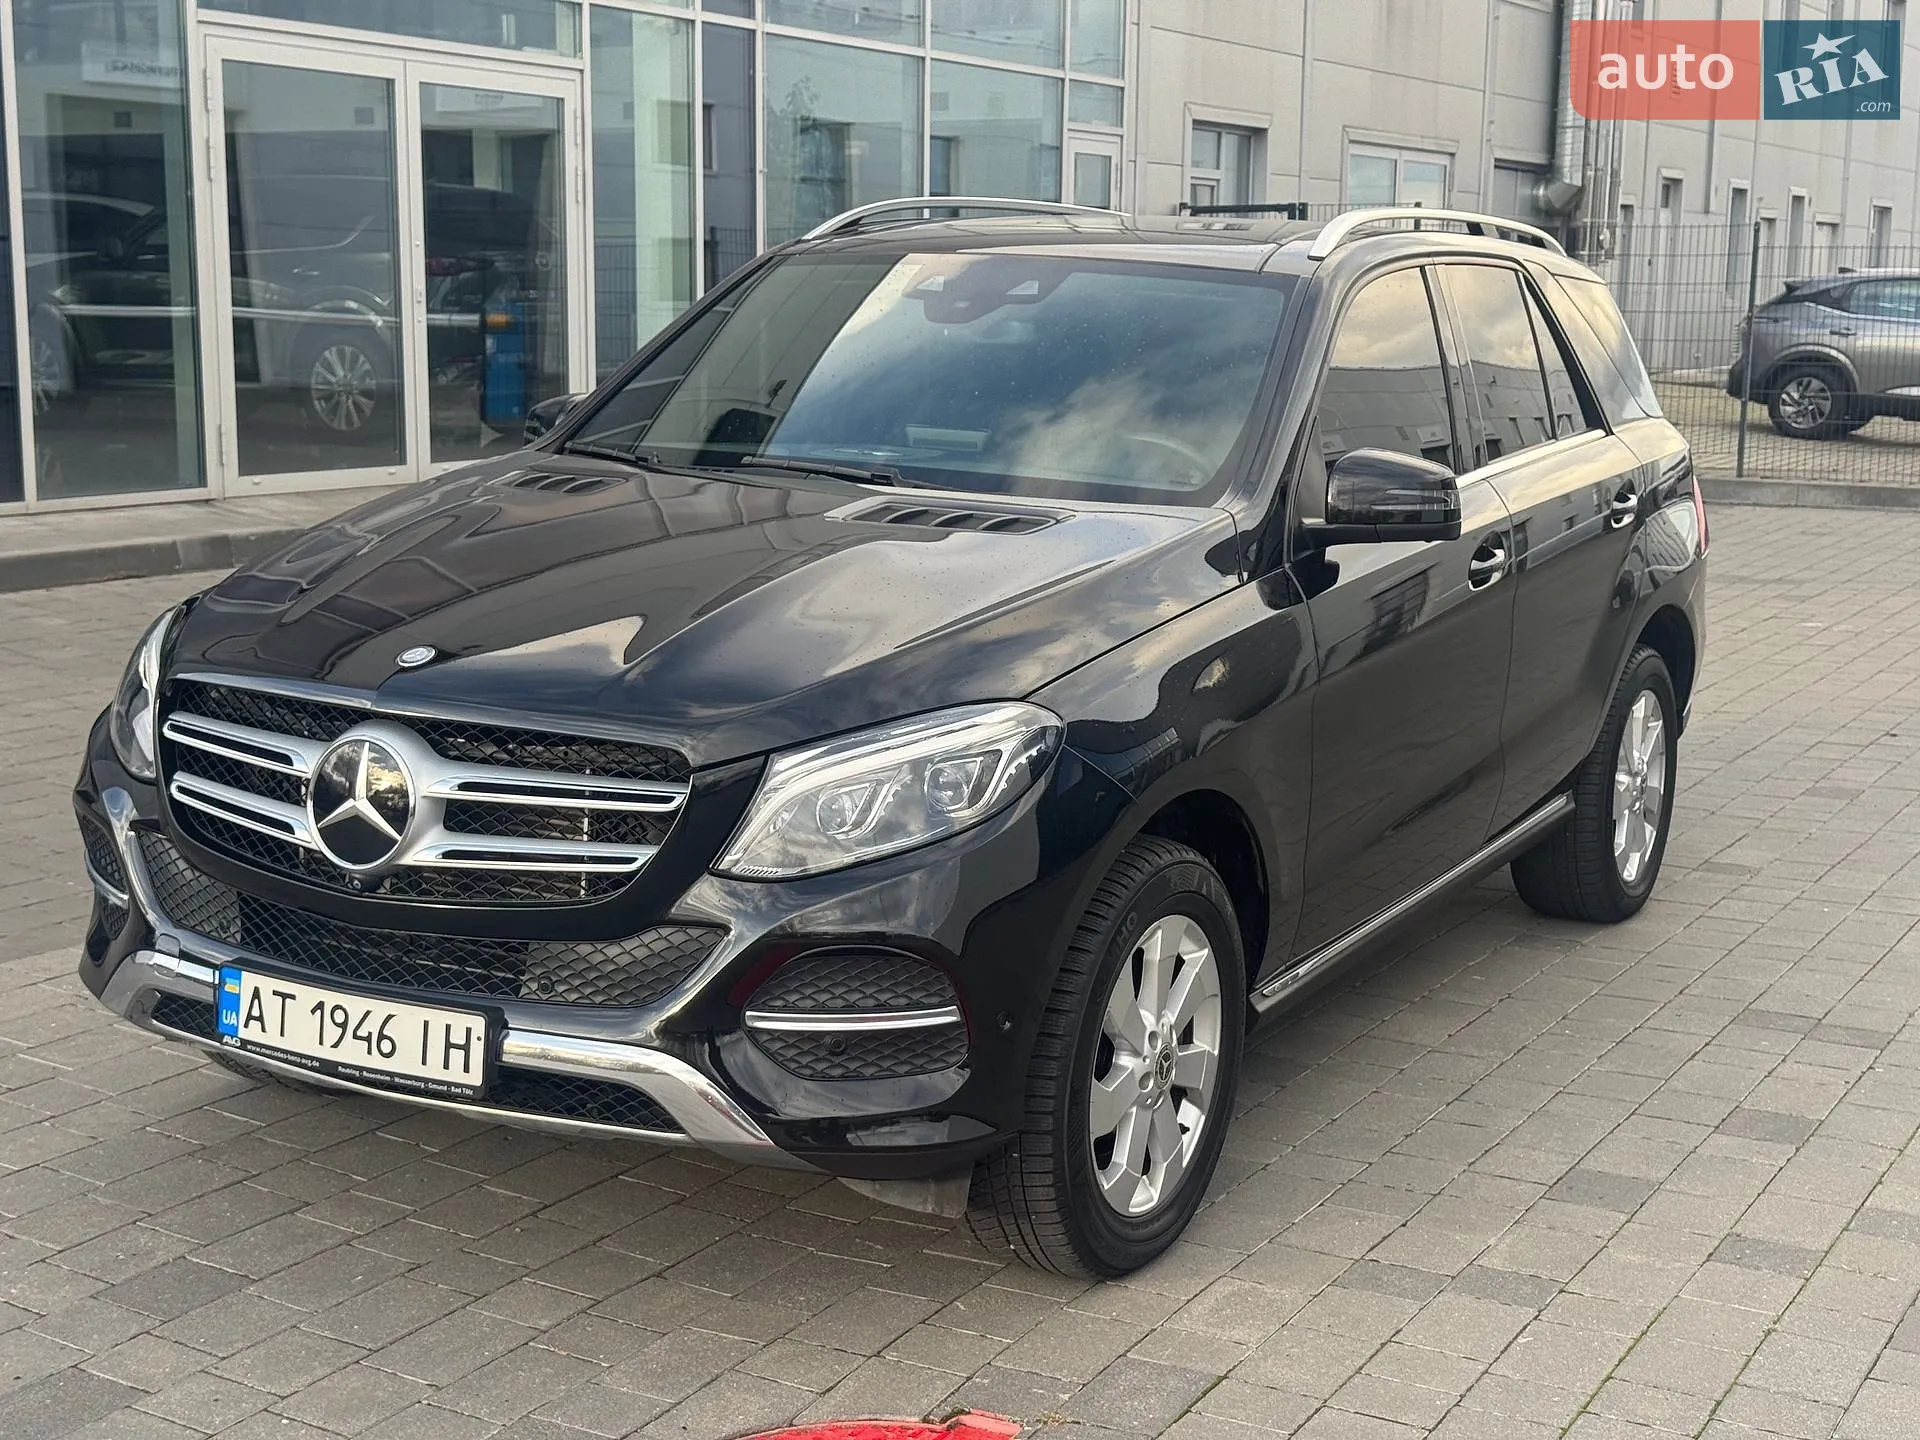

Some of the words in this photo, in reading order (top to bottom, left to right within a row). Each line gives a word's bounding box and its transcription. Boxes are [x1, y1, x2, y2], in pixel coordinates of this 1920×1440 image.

[222, 1009, 238, 1027] UA
[243, 985, 297, 1038] AT
[310, 1000, 397, 1059] 1946
[421, 1019, 472, 1074] IH
